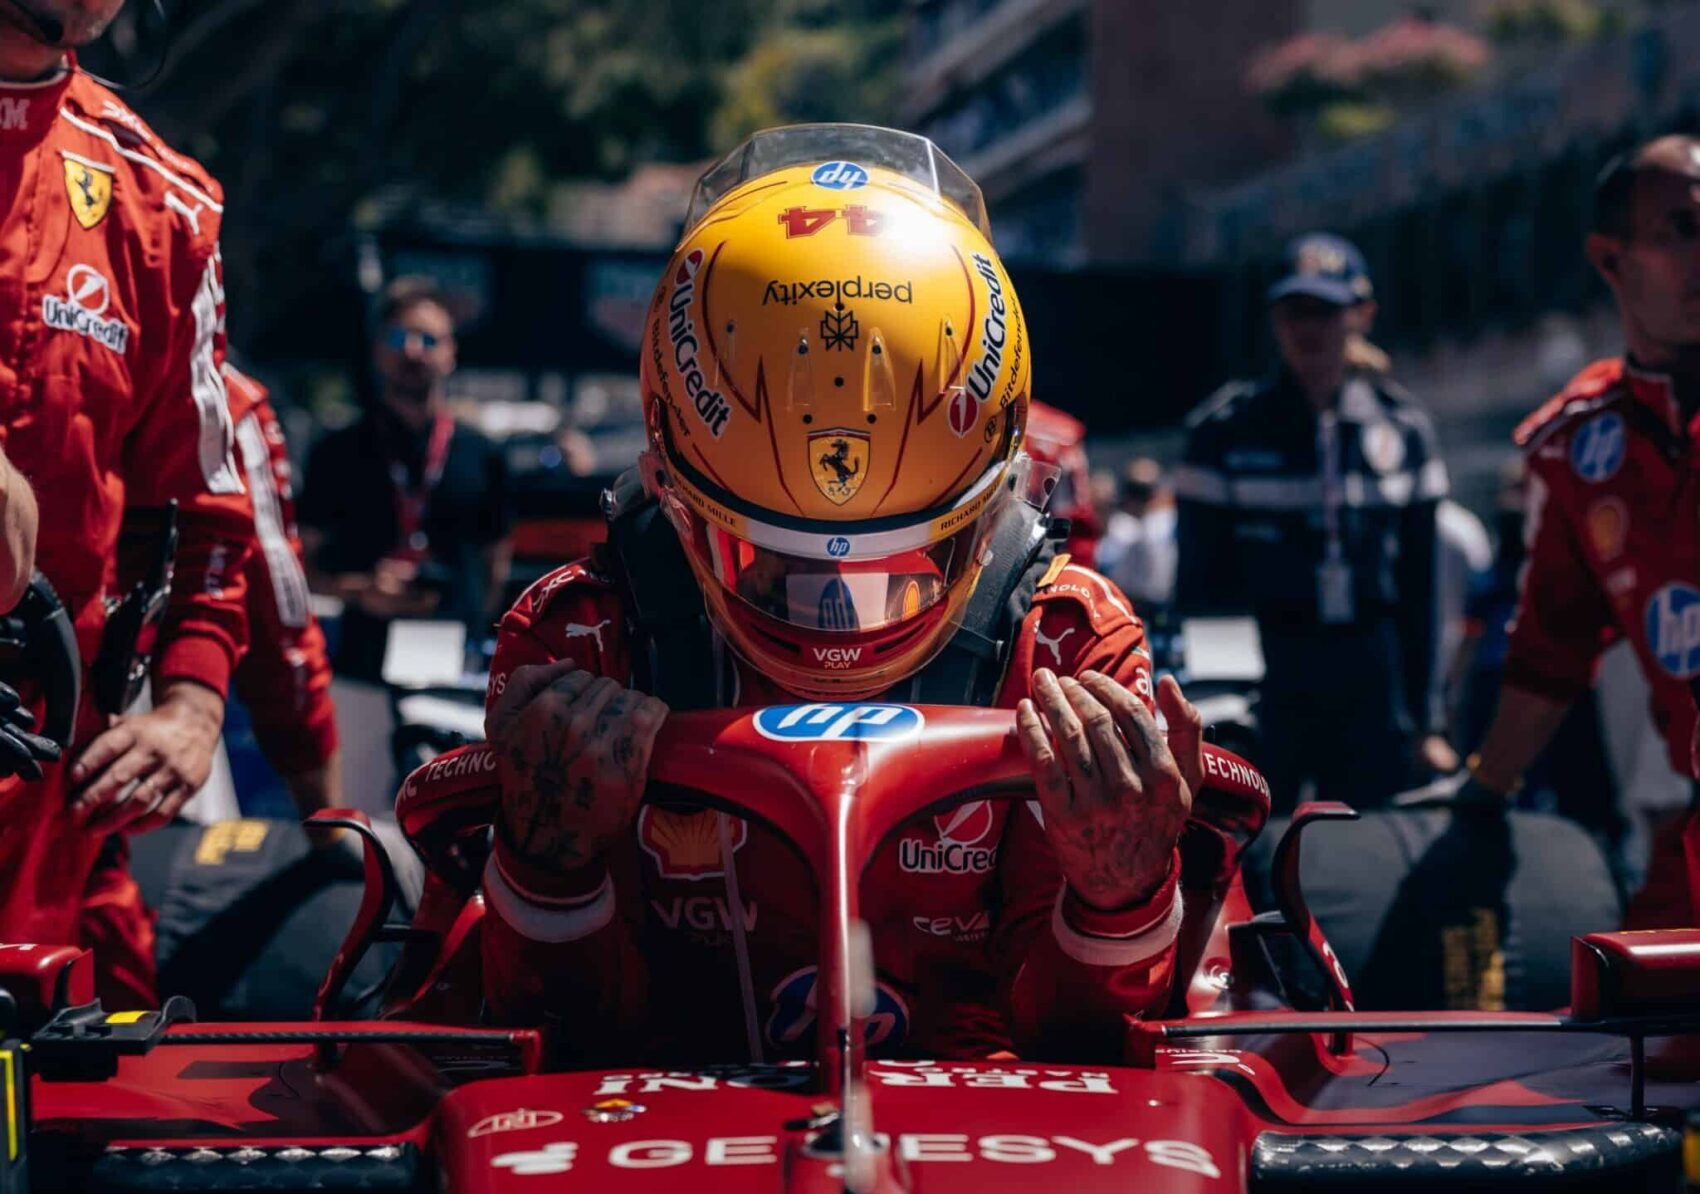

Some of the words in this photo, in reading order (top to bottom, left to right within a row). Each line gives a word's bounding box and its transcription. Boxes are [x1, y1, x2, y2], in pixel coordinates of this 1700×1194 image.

[779, 205, 890, 238] 44
[763, 275, 912, 305] perplexity
[45, 297, 128, 351] UniCredit
[968, 254, 1006, 400] UniCredit
[670, 284, 729, 437] UniCredit
[829, 537, 849, 556] hp
[813, 647, 862, 661] VGW
[825, 661, 851, 669] PLAY
[774, 703, 904, 737] hp
[650, 897, 758, 932] VGW
[608, 1133, 1221, 1179] GEESYS
